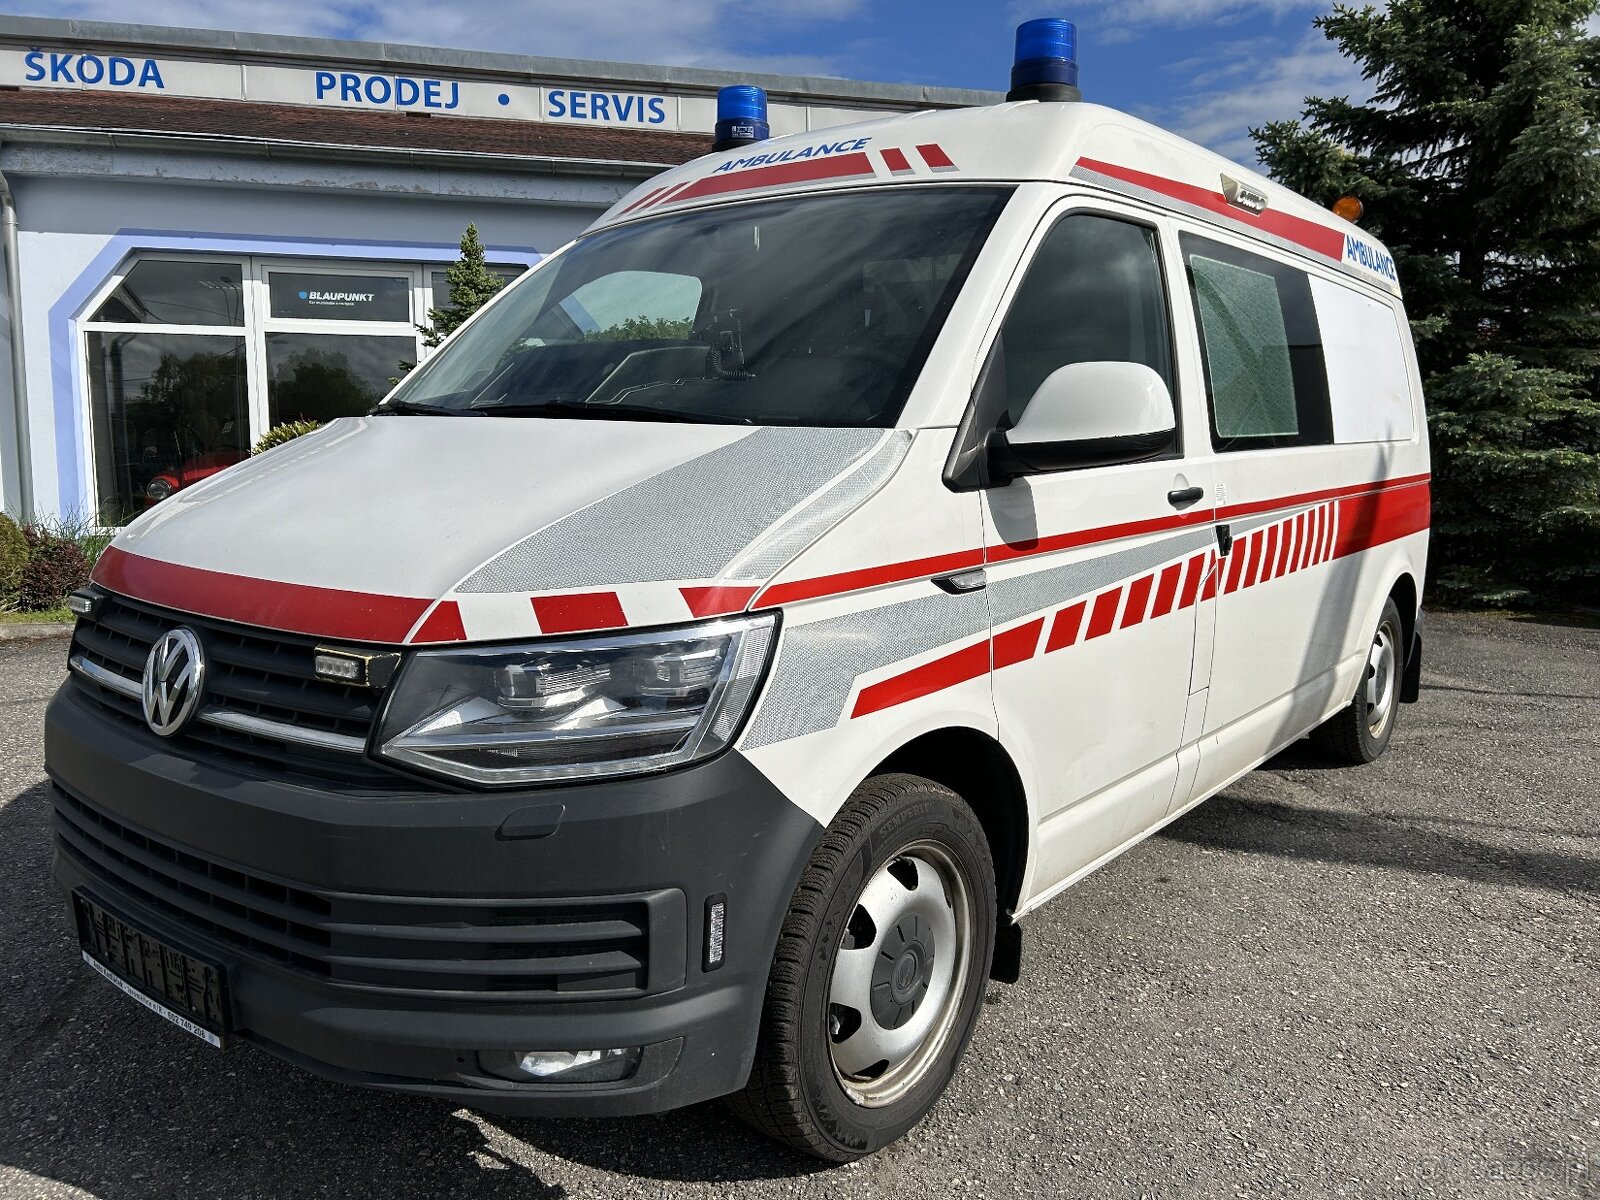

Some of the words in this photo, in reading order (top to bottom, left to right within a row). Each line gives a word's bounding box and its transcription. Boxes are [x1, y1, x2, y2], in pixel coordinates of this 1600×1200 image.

[24, 46, 165, 89] ŠKODA
[315, 71, 459, 110] PRODEJ
[548, 89, 666, 125] SERVIS
[712, 136, 873, 174] AMBULANCE
[1346, 234, 1396, 282] AMBULANCE
[308, 291, 375, 302] BLAUPUNKT
